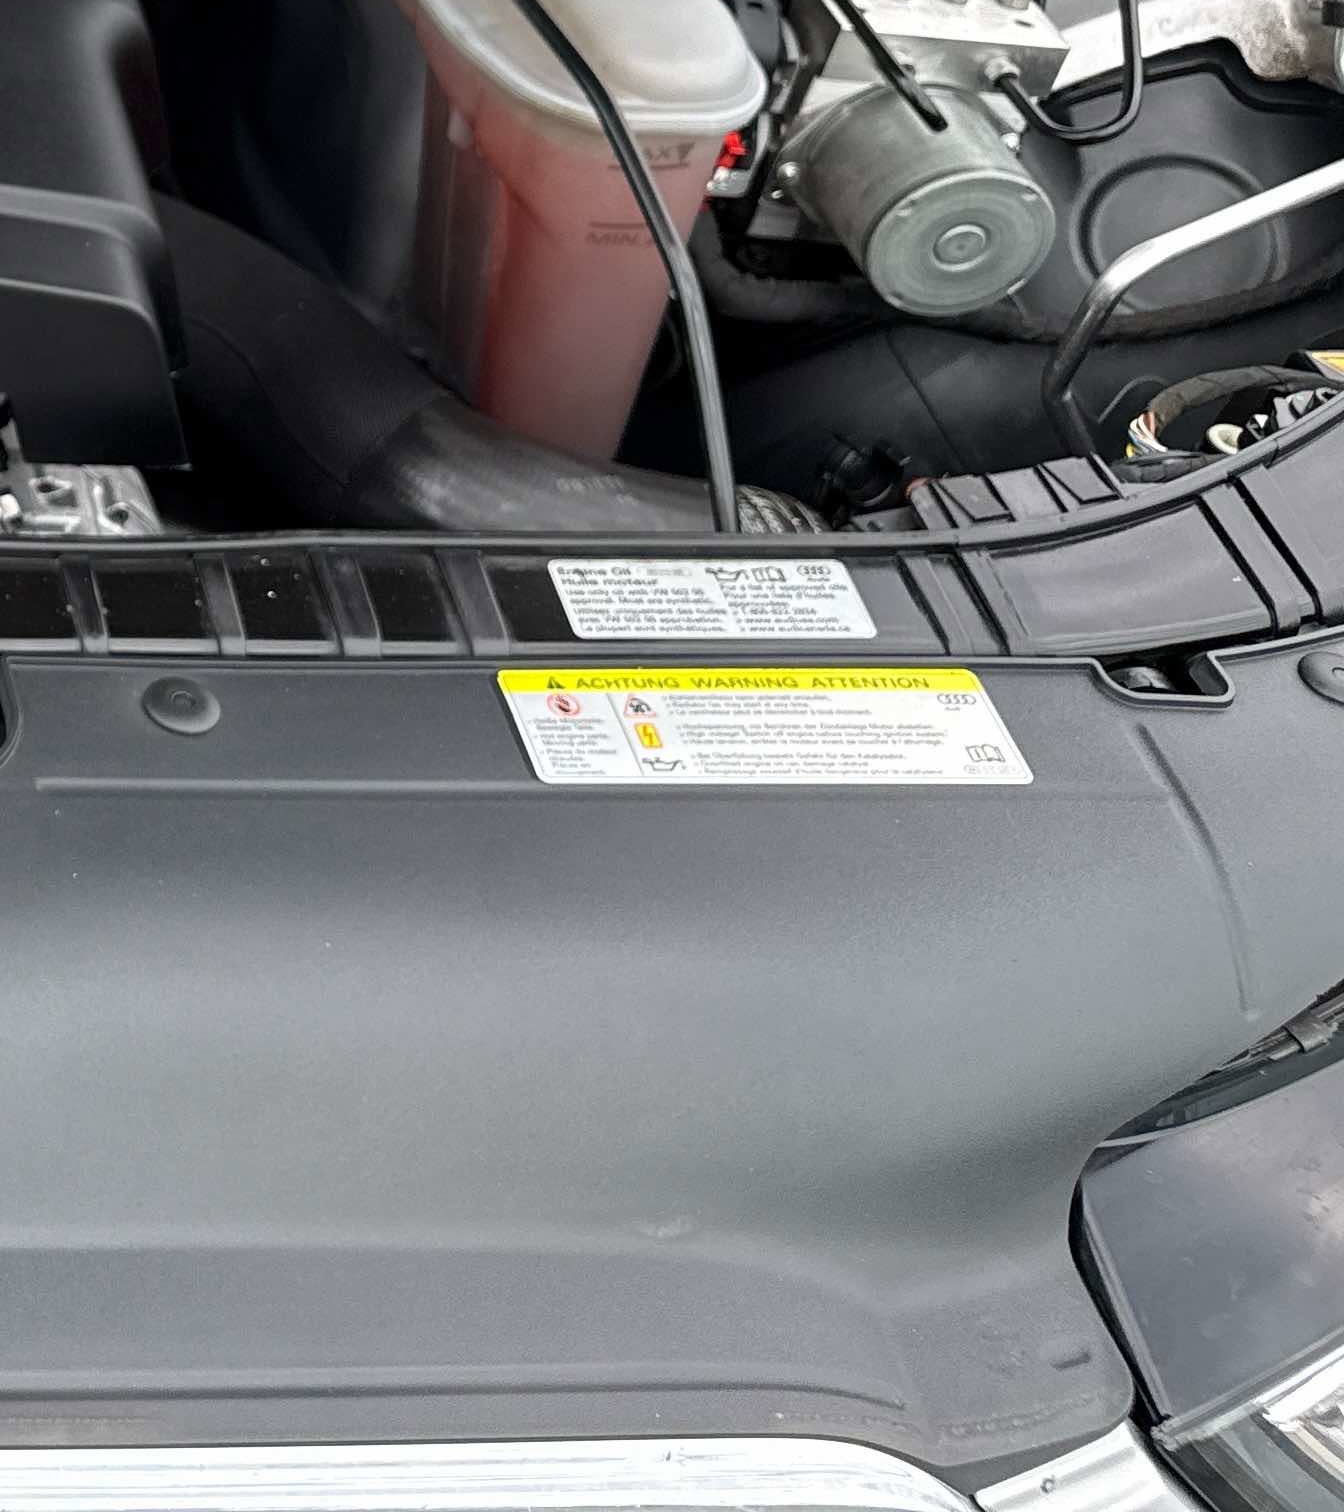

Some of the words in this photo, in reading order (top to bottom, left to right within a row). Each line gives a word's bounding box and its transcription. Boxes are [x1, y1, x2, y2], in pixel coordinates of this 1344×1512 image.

[576, 676, 681, 689] ACHTUNG
[689, 676, 799, 689] WARNING
[812, 676, 931, 689] ATTENTION
